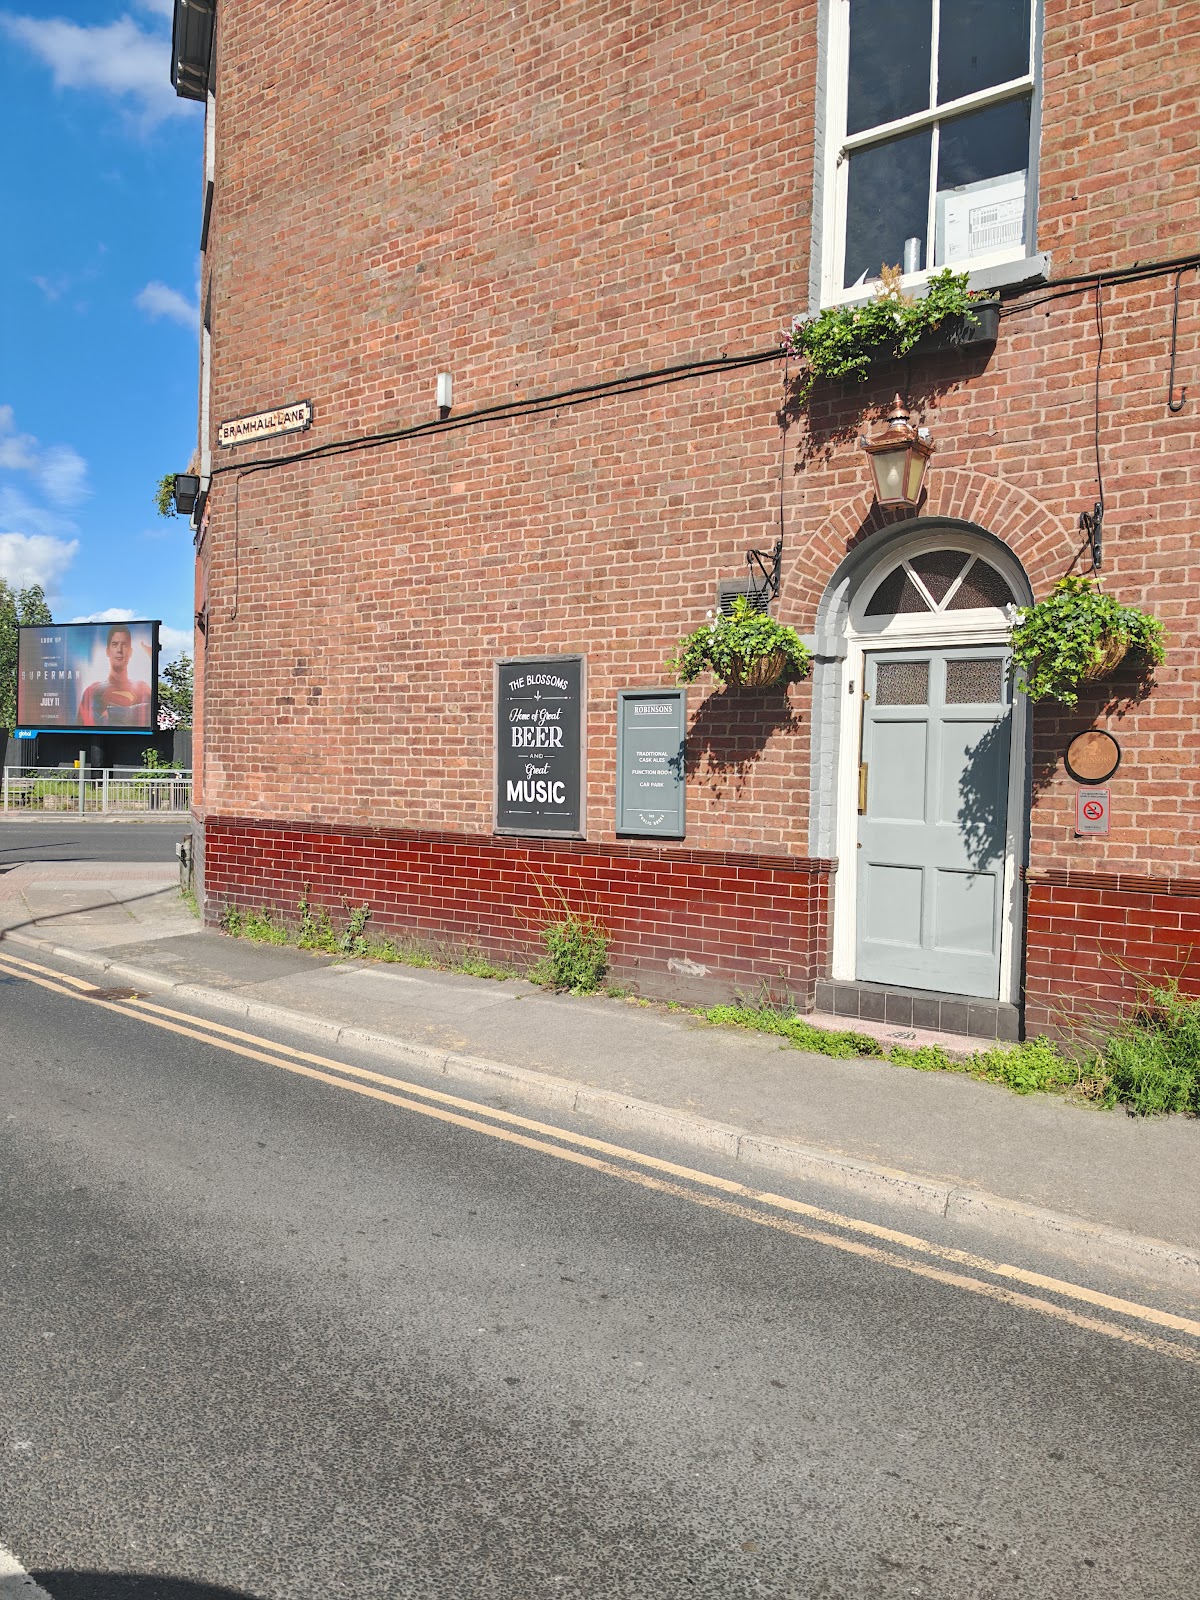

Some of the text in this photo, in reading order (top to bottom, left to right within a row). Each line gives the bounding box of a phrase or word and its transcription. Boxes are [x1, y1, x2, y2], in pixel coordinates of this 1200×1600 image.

[223, 408, 304, 438] BRAMHALL LANE
[21, 670, 81, 680] SUPERMAN
[508, 674, 569, 691] THE BLOSSOMS
[40, 698, 60, 706] JULY 11
[634, 705, 673, 713] ROBINSONS
[509, 708, 563, 726] Home of Great
[511, 726, 564, 748] BEER
[525, 762, 551, 780] Great
[506, 780, 566, 804] MUSIC
